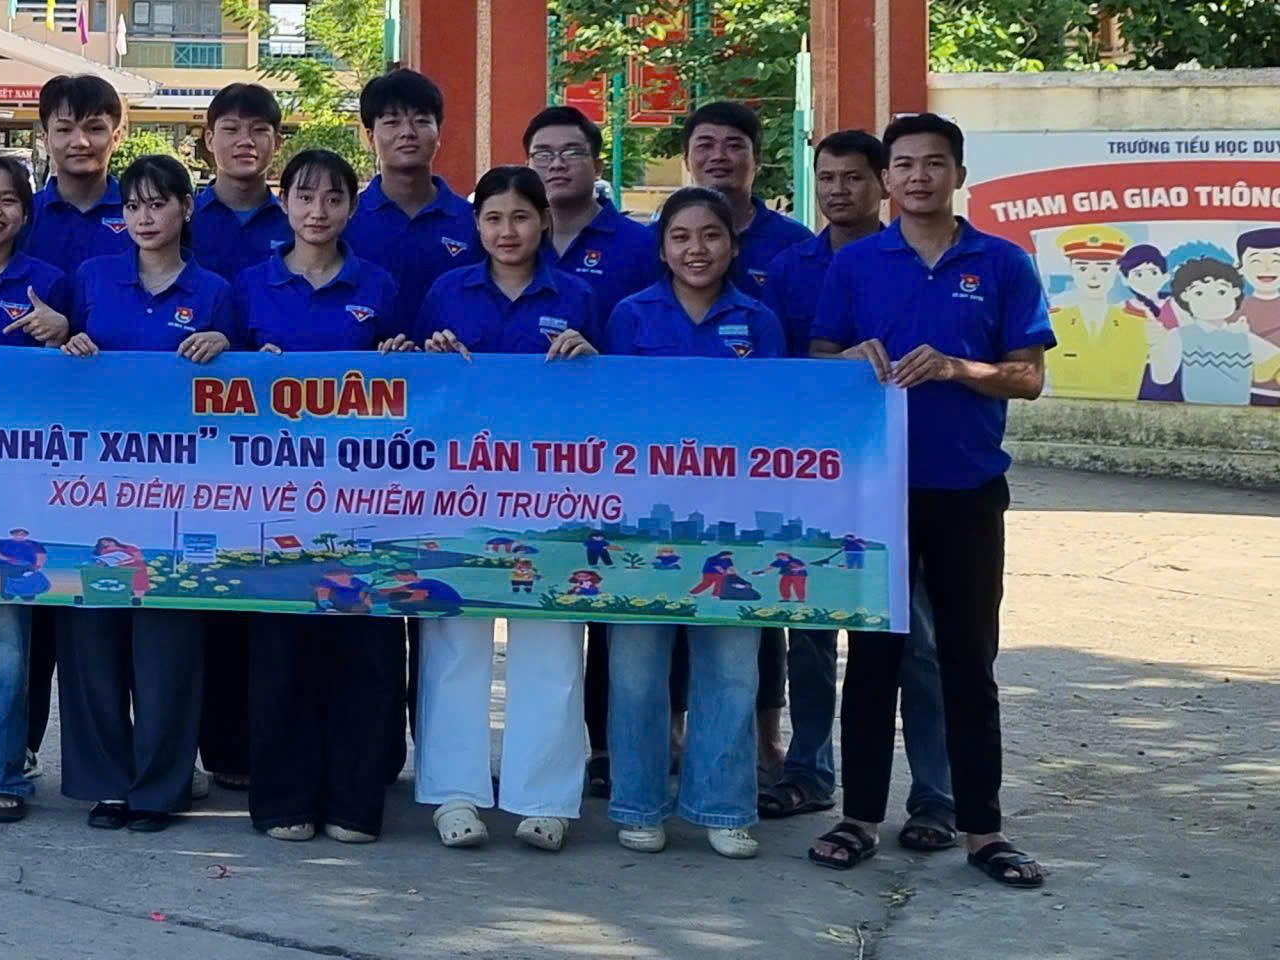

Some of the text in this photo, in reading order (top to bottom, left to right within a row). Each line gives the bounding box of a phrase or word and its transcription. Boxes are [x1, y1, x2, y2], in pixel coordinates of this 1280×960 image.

[15, 88, 33, 99] NAM
[1108, 138, 1170, 154] TRƯỜNG
[1215, 140, 1248, 156] HỌC
[989, 194, 1068, 223] THAM
[1072, 190, 1119, 212] GIA
[1123, 186, 1189, 208] GIAO
[193, 371, 405, 419] RA QUÂN
[229, 430, 325, 468] TOÀN
[337, 428, 435, 472] QUỐC
[449, 430, 519, 472] LẦN
[532, 436, 606, 474] THỨ
[614, 444, 636, 475] 2
[649, 440, 736, 478] NĂM
[749, 447, 841, 480] 2026
[48, 474, 623, 521] XÓA ĐIỂM ĐEN VỀ Ô NHIỄM MÔI TRƯỜNG
